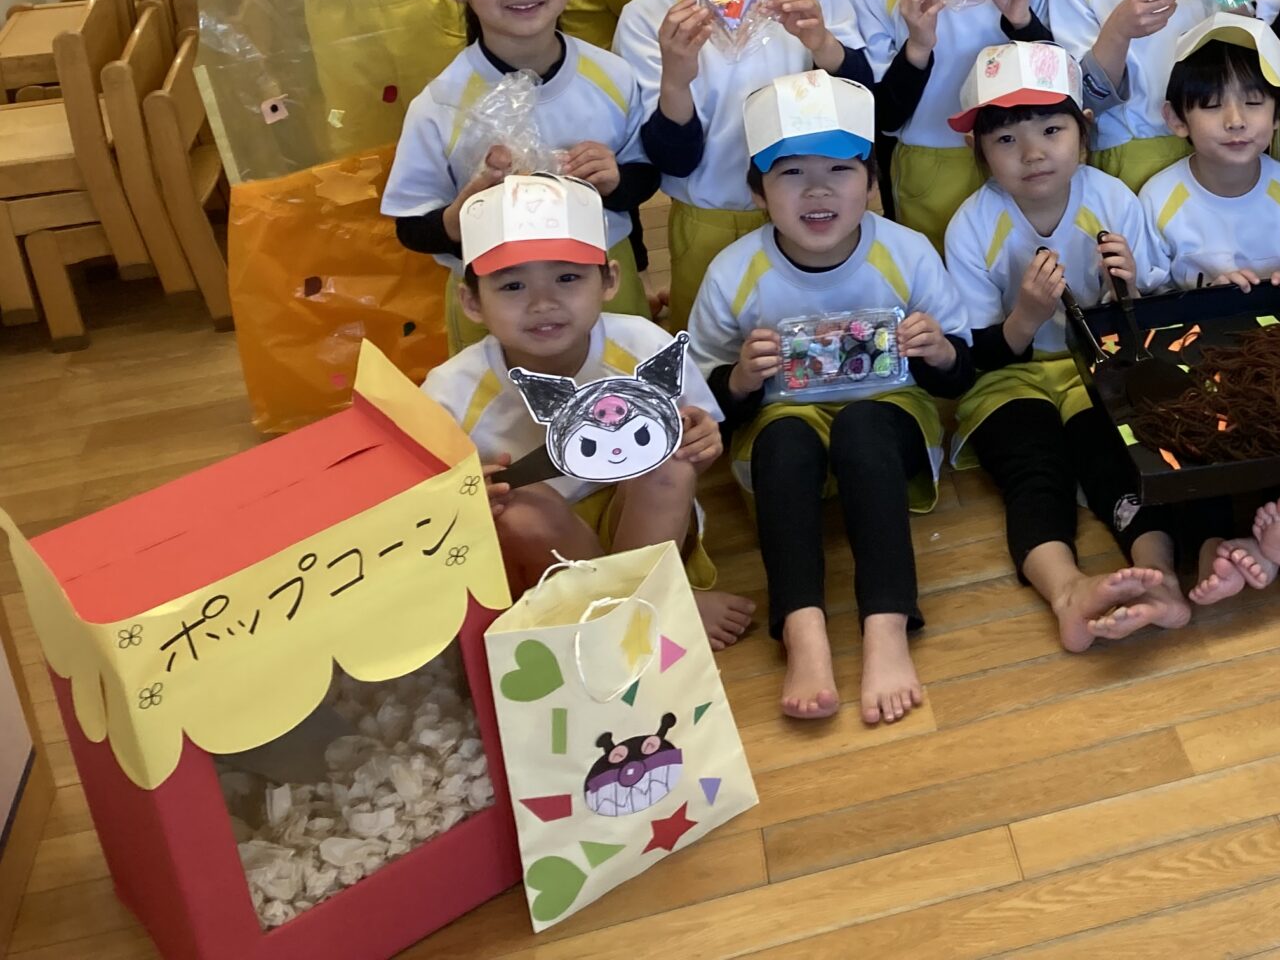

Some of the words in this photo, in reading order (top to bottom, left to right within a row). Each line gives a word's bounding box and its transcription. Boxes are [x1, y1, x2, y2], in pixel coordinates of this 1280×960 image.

[159, 511, 459, 673] ポップコーン
